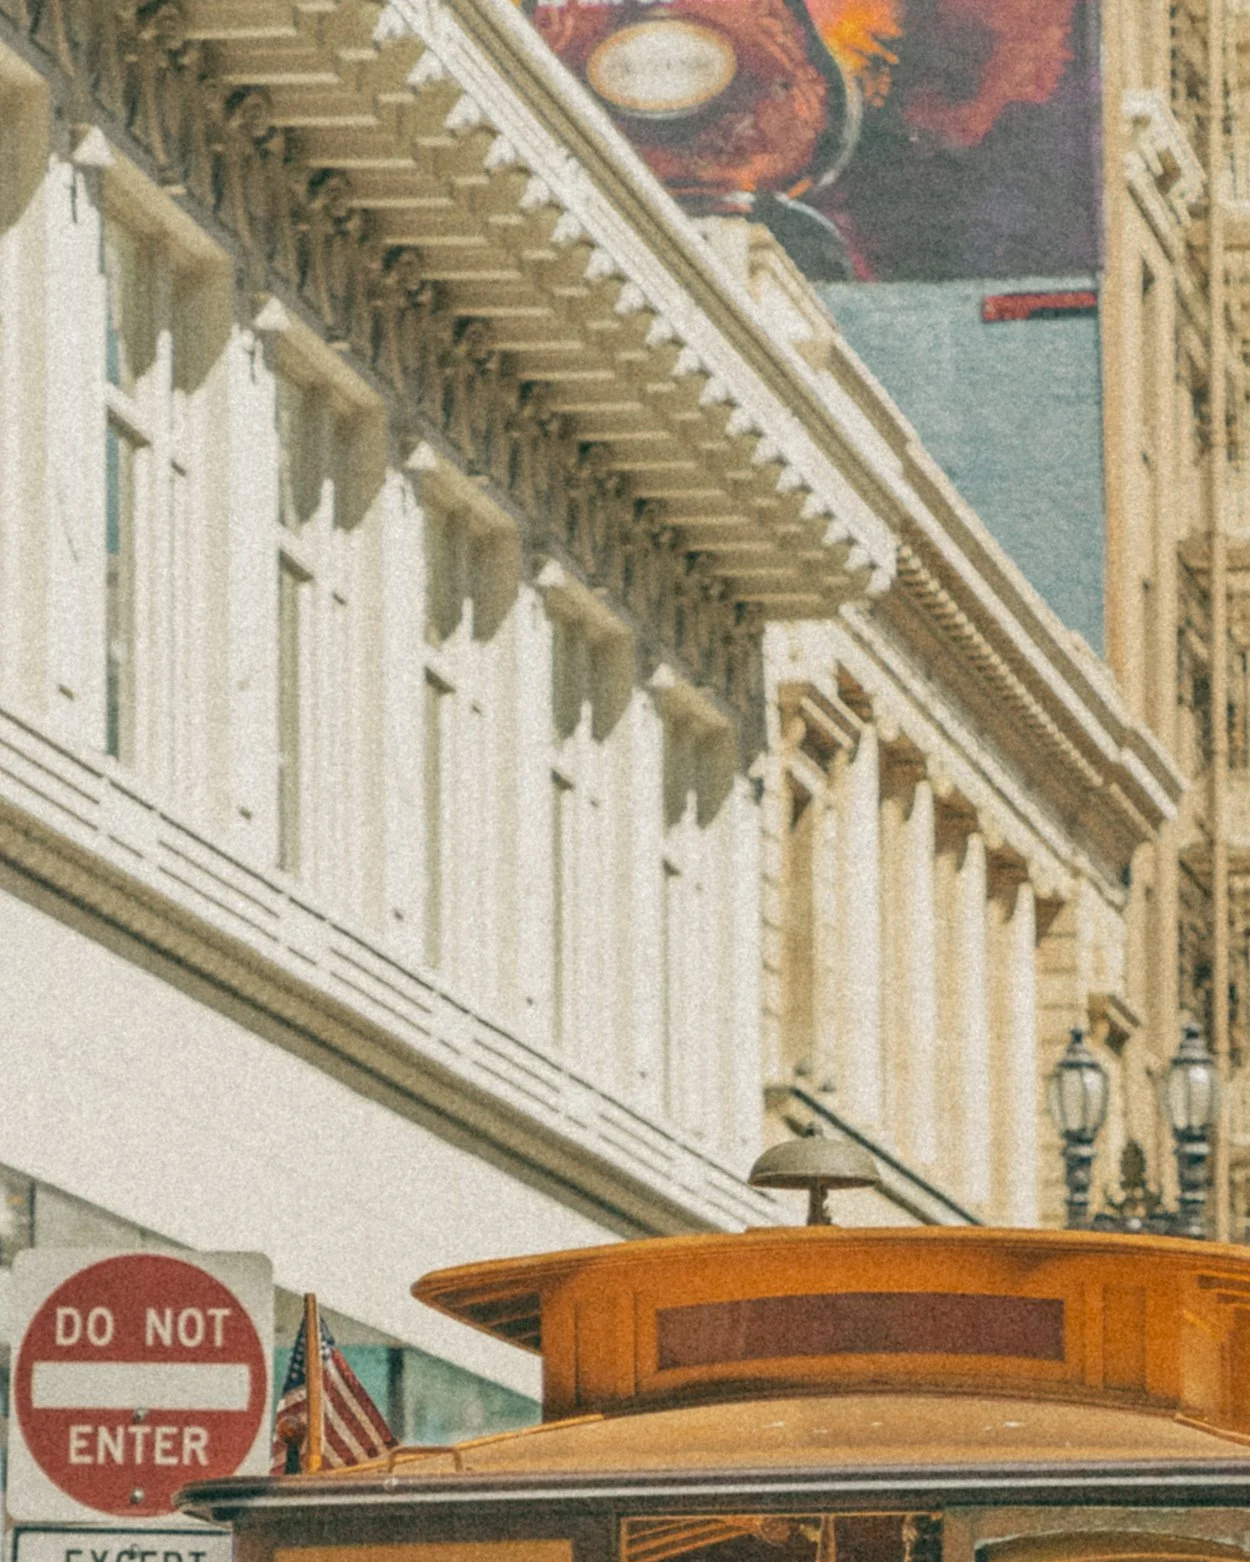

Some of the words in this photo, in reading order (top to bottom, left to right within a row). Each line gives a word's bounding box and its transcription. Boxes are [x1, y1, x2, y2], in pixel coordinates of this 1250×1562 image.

[55, 1307, 115, 1347] DO
[144, 1307, 231, 1347] NOT
[68, 1425, 210, 1466] ENTER
